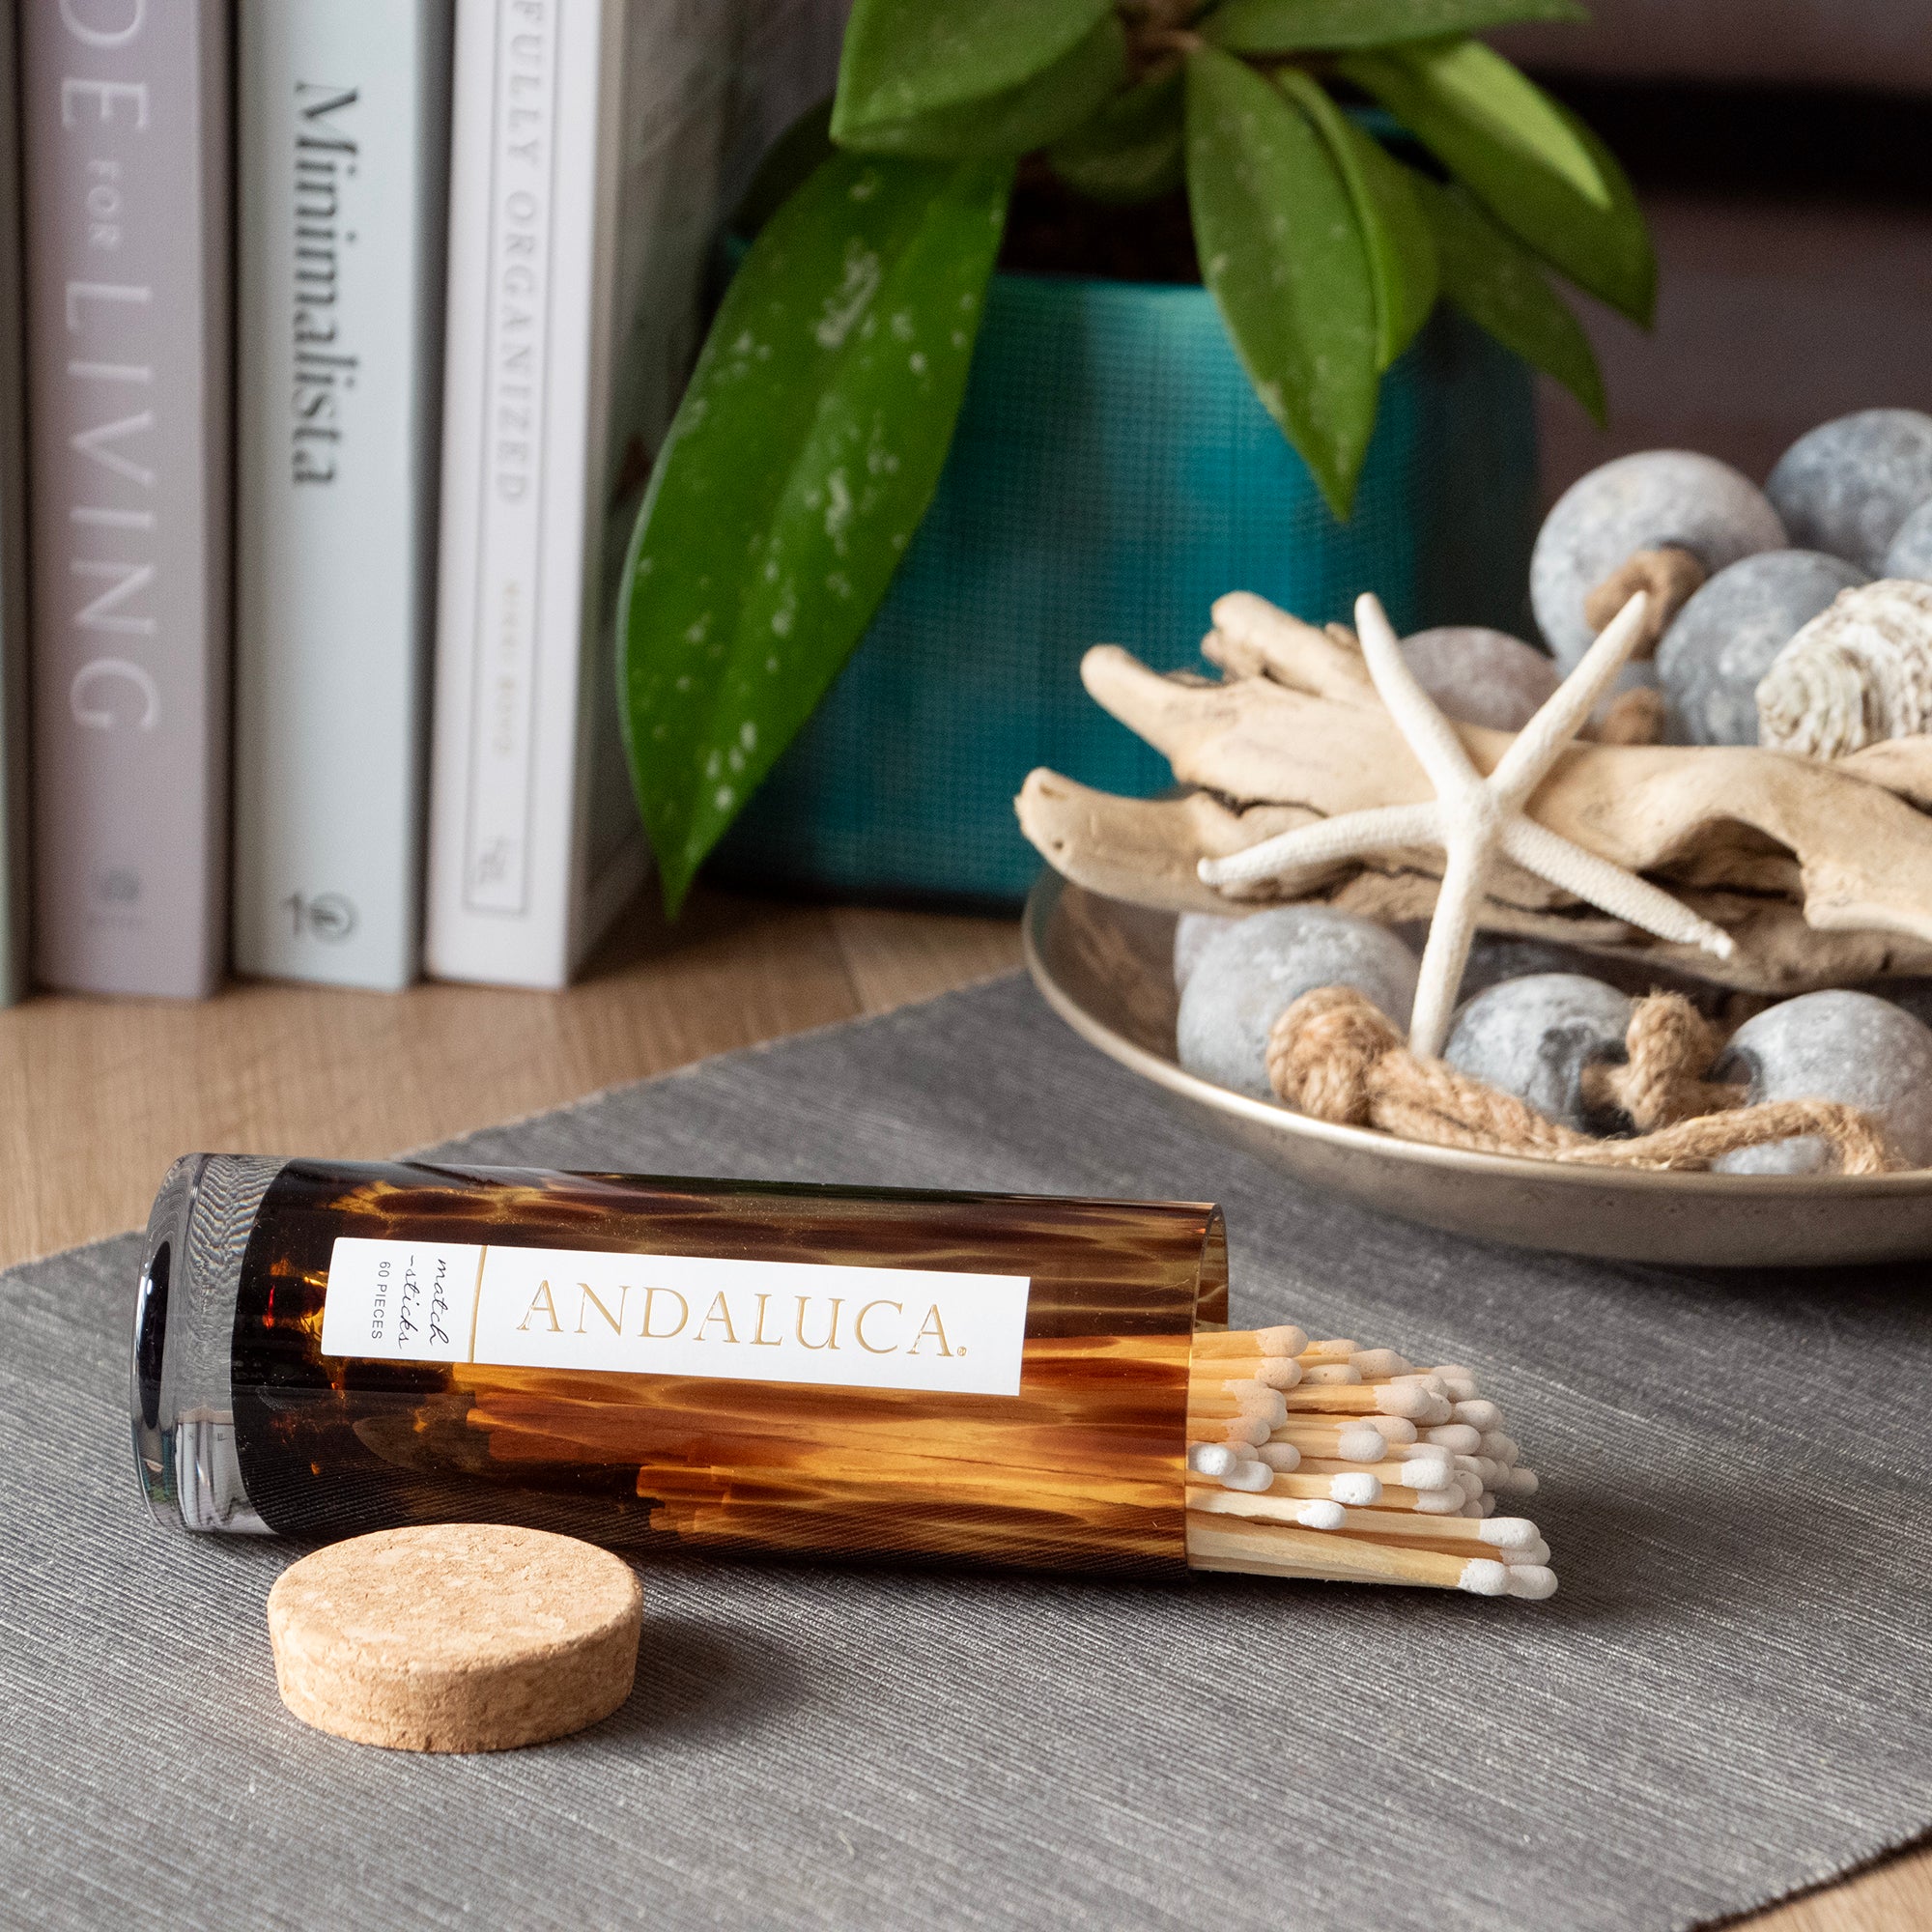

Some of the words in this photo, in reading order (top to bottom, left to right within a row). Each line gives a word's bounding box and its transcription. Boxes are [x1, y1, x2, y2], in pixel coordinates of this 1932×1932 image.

[506, 0, 545, 167] FULLY
[87, 158, 123, 251] FOR
[292, 80, 360, 486] Minimalista
[496, 189, 543, 505] ORGANIZED
[69, 281, 159, 732] LIVING
[371, 1284, 387, 1340] PIECES
[379, 1261, 390, 1278] 60
[429, 1259, 449, 1346] match
